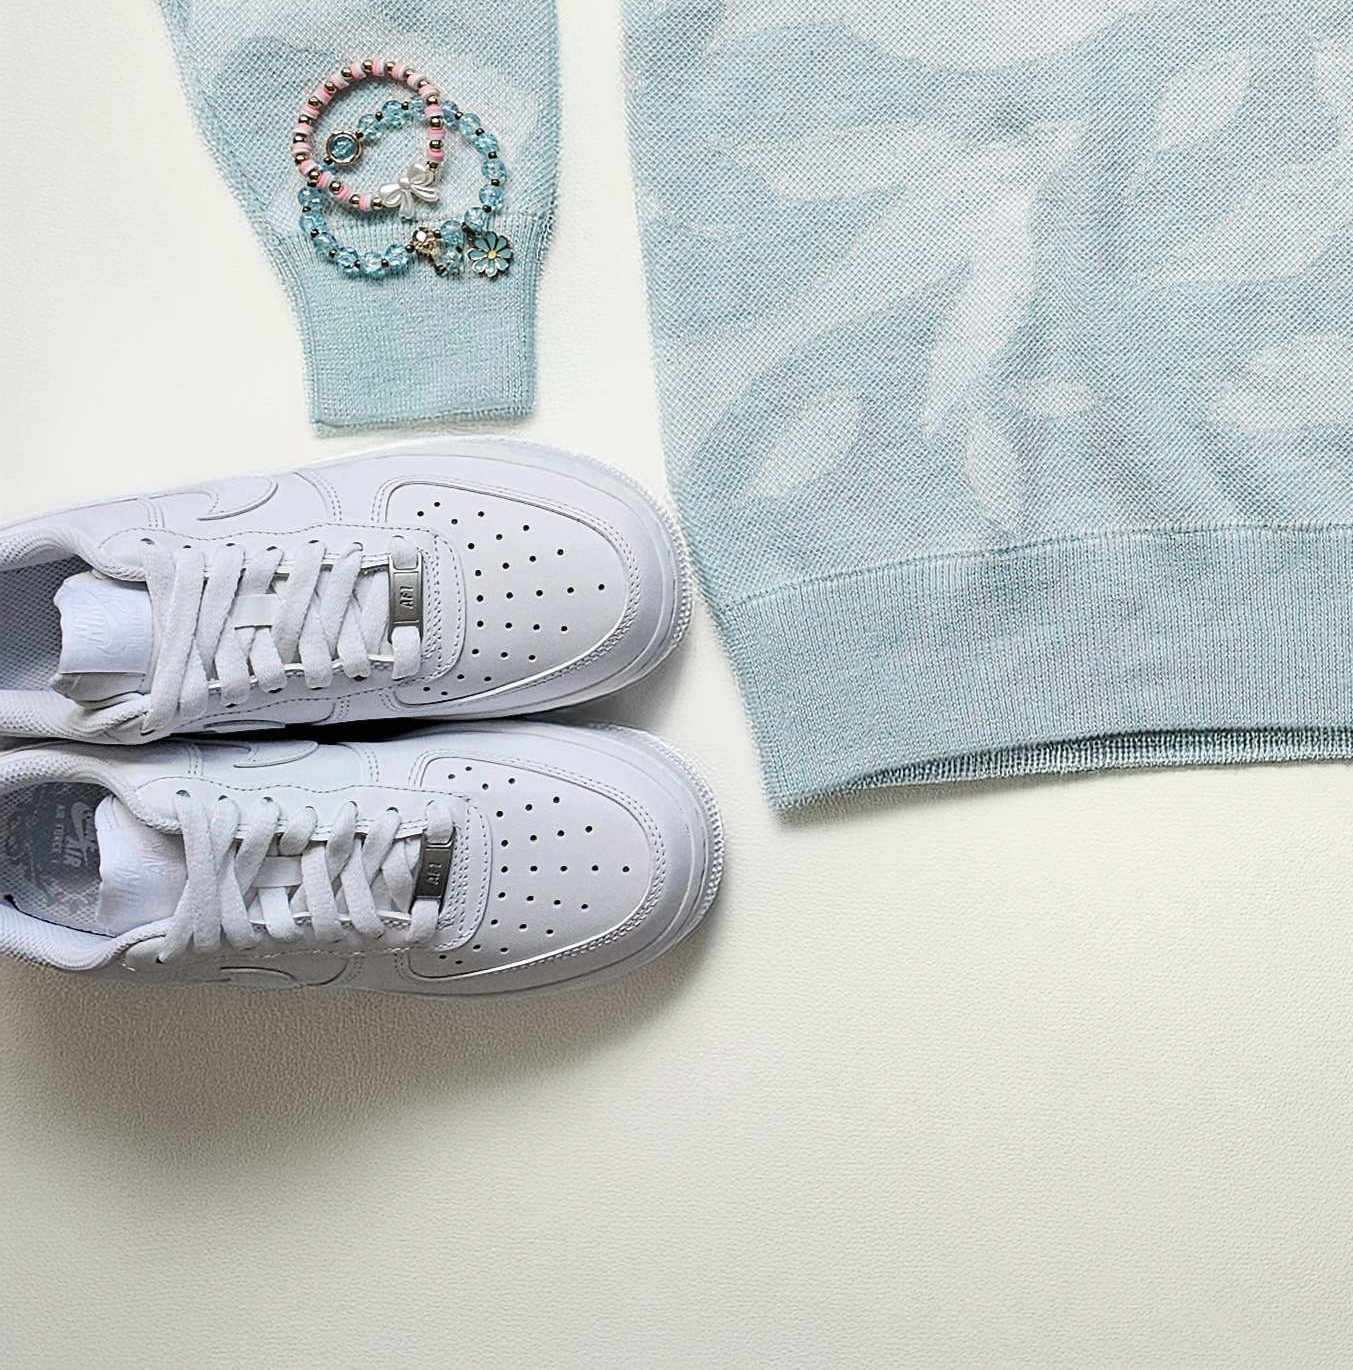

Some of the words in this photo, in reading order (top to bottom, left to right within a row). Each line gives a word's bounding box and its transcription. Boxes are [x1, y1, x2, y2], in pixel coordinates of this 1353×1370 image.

[400, 585, 414, 610] AF1
[72, 603, 105, 645] NIK
[63, 835, 83, 868] AIR
